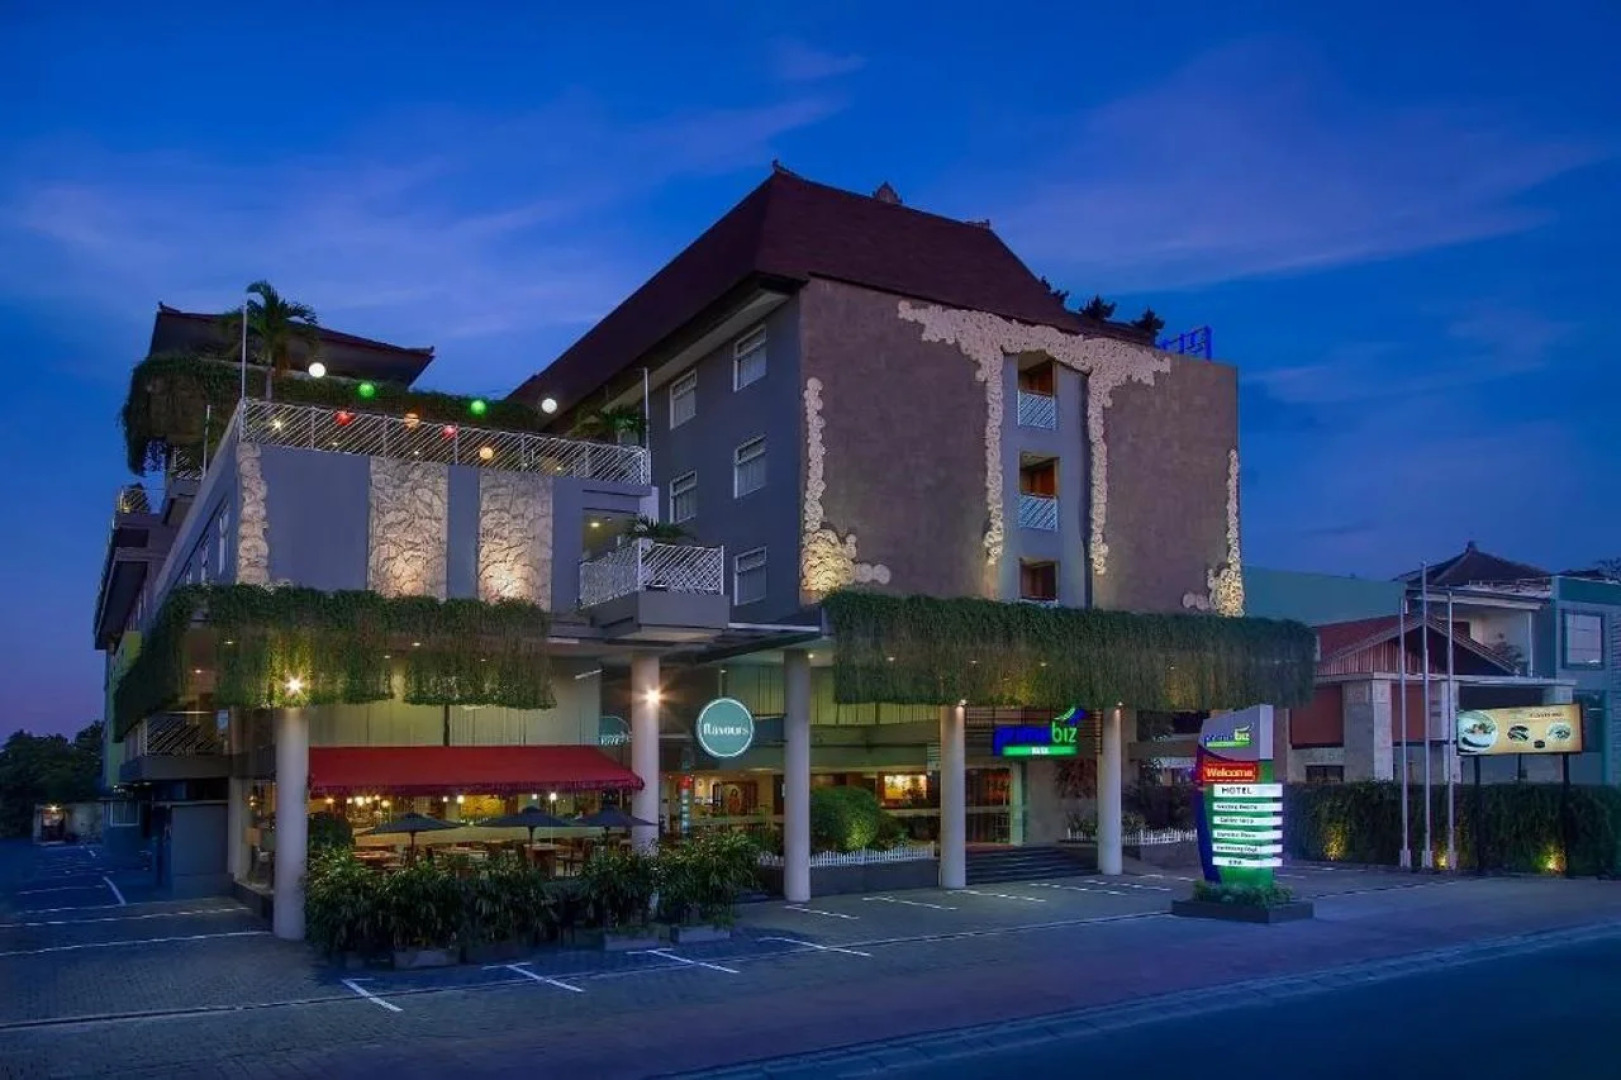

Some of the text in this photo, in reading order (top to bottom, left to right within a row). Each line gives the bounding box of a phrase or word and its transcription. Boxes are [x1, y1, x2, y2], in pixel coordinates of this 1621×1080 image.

[703, 723, 749, 735] flavours
[1206, 767, 1253, 777] Welcome
[1221, 787, 1252, 795] HOTEL
